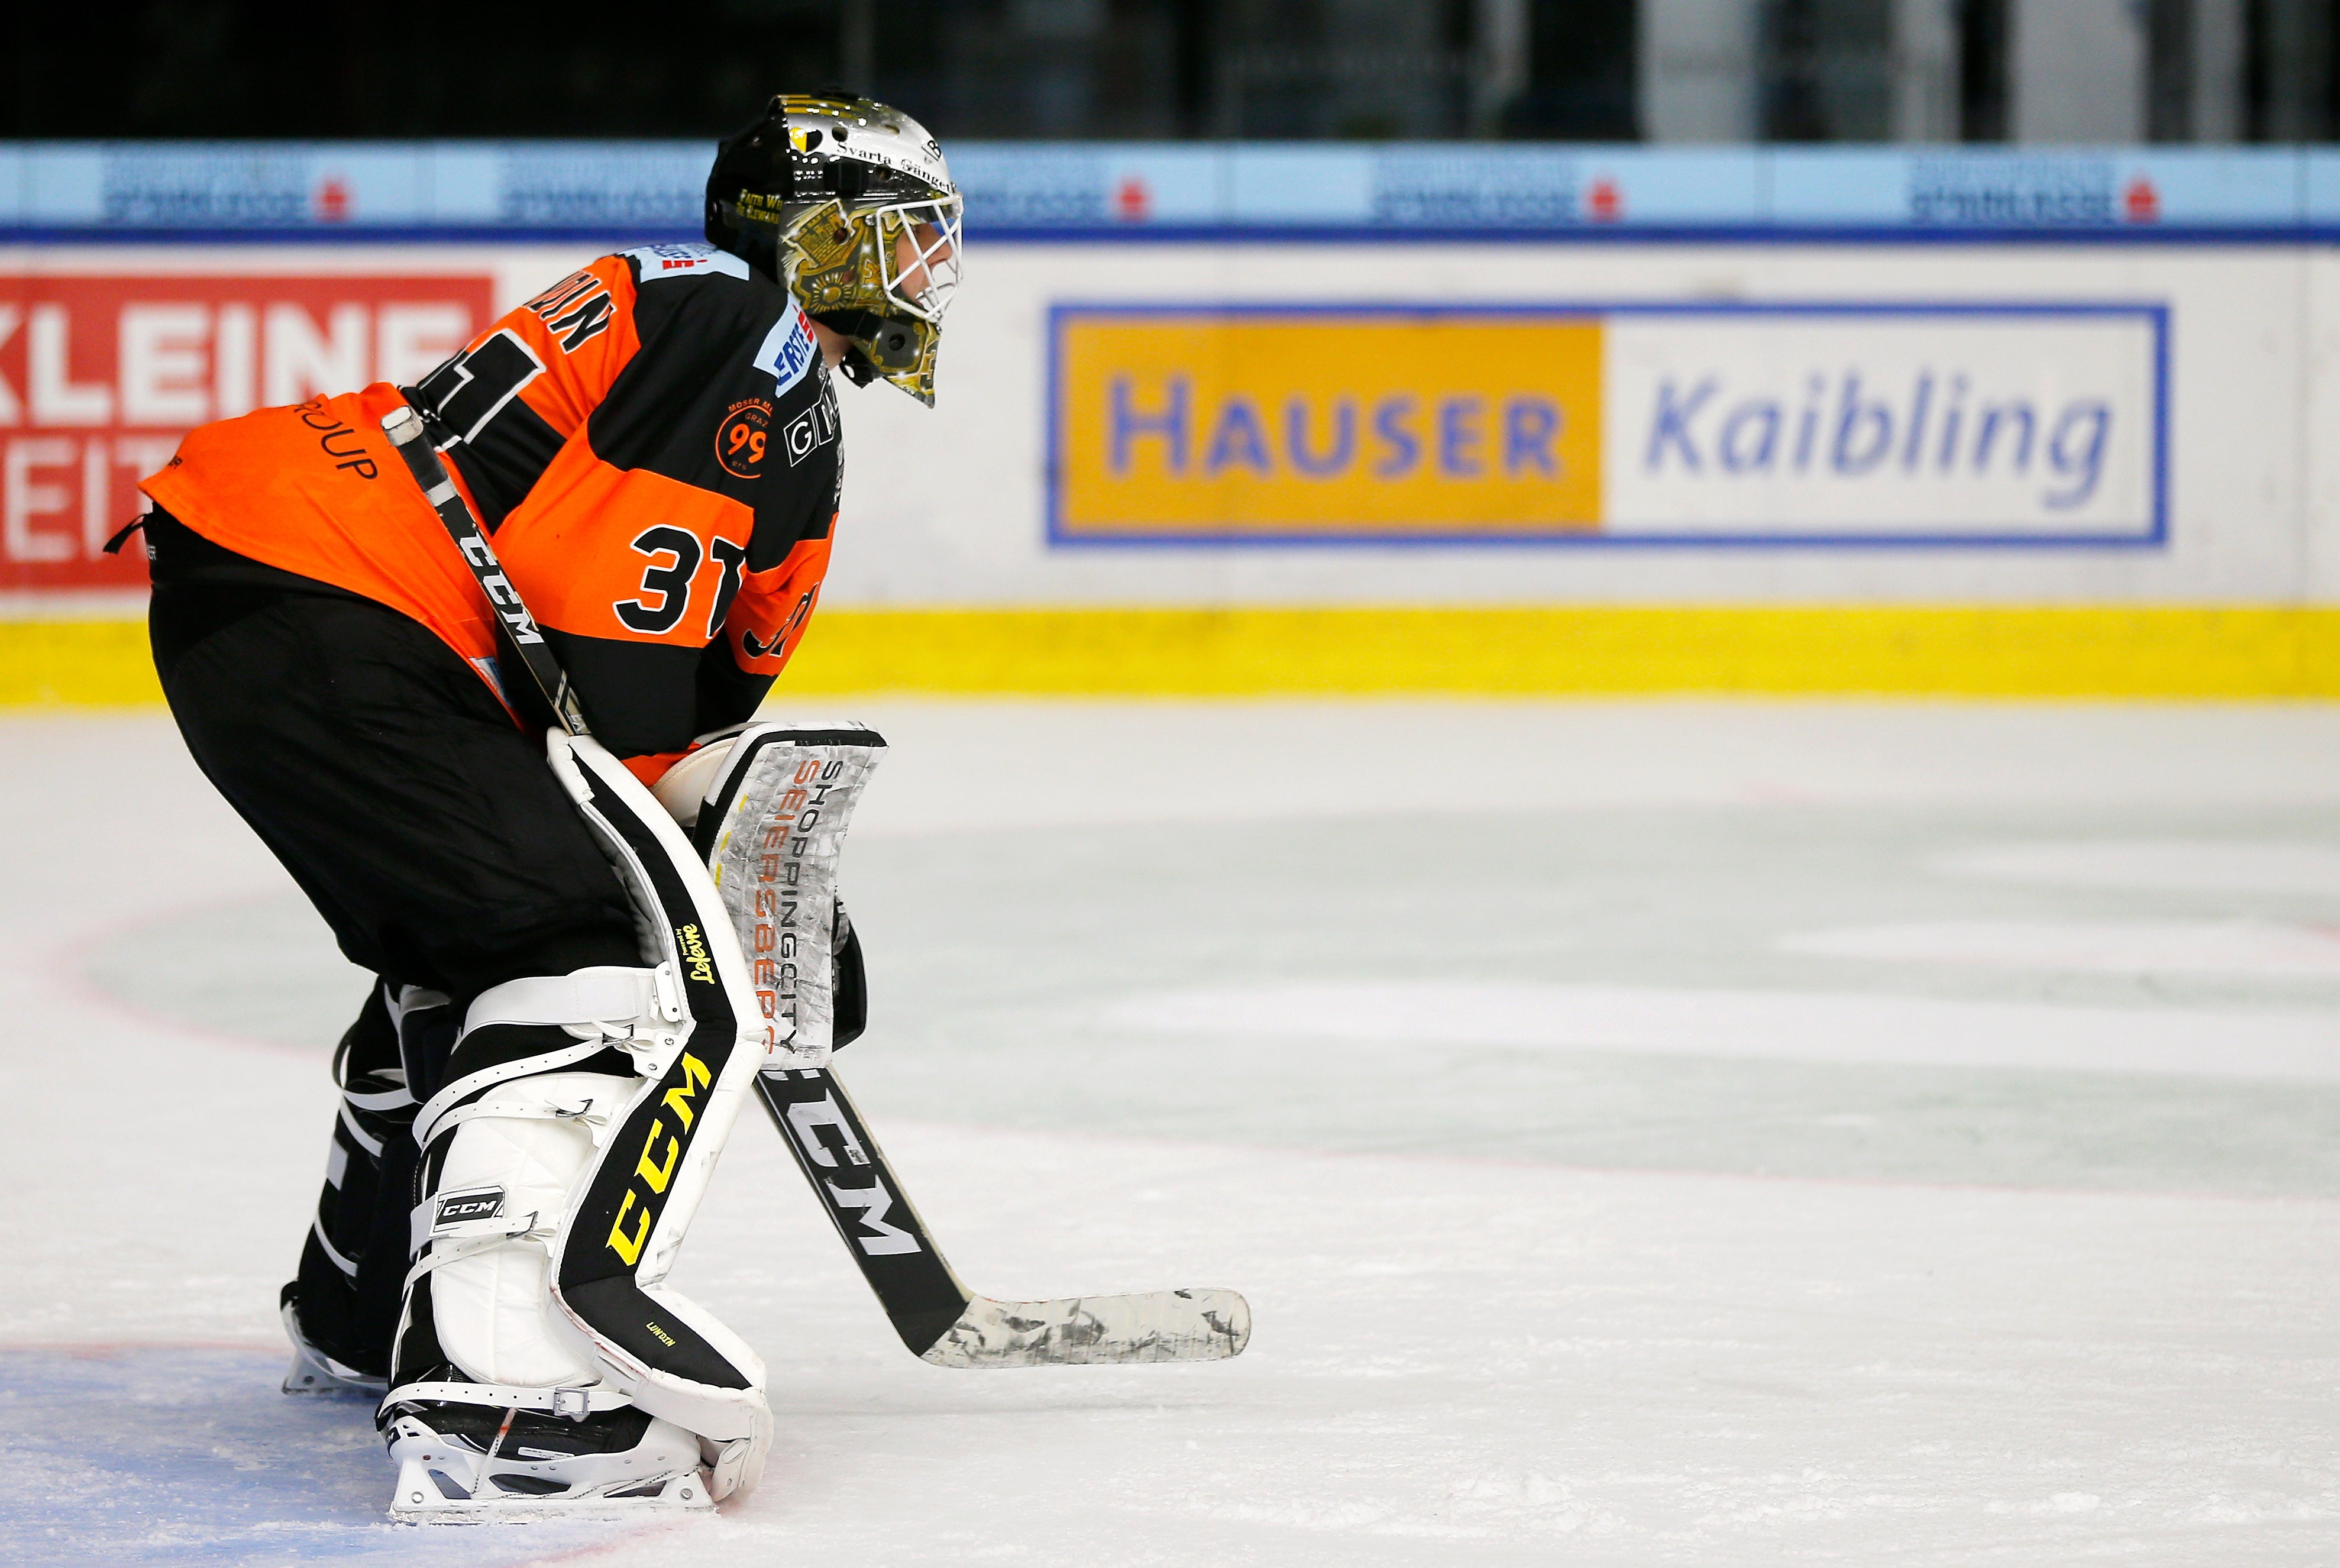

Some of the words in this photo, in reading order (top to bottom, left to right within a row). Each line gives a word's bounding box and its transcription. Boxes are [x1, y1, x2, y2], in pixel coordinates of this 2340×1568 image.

[837, 142, 891, 164] Svarta
[774, 322, 810, 386] ERSTE
[728, 398, 761, 412] MOSER
[745, 412, 769, 428] GRAZ
[728, 423, 767, 464] 99
[1107, 371, 1565, 478] HAUSER
[1641, 370, 2113, 513] Kaibling
[458, 532, 545, 645] CCM
[612, 523, 746, 639] 31
[780, 760, 841, 1055] SHOPPINGCITY
[606, 1052, 712, 1266] CCM
[761, 1068, 922, 1256] CM
[442, 1200, 497, 1217] CCM
[645, 1321, 676, 1347] LUNDIN
